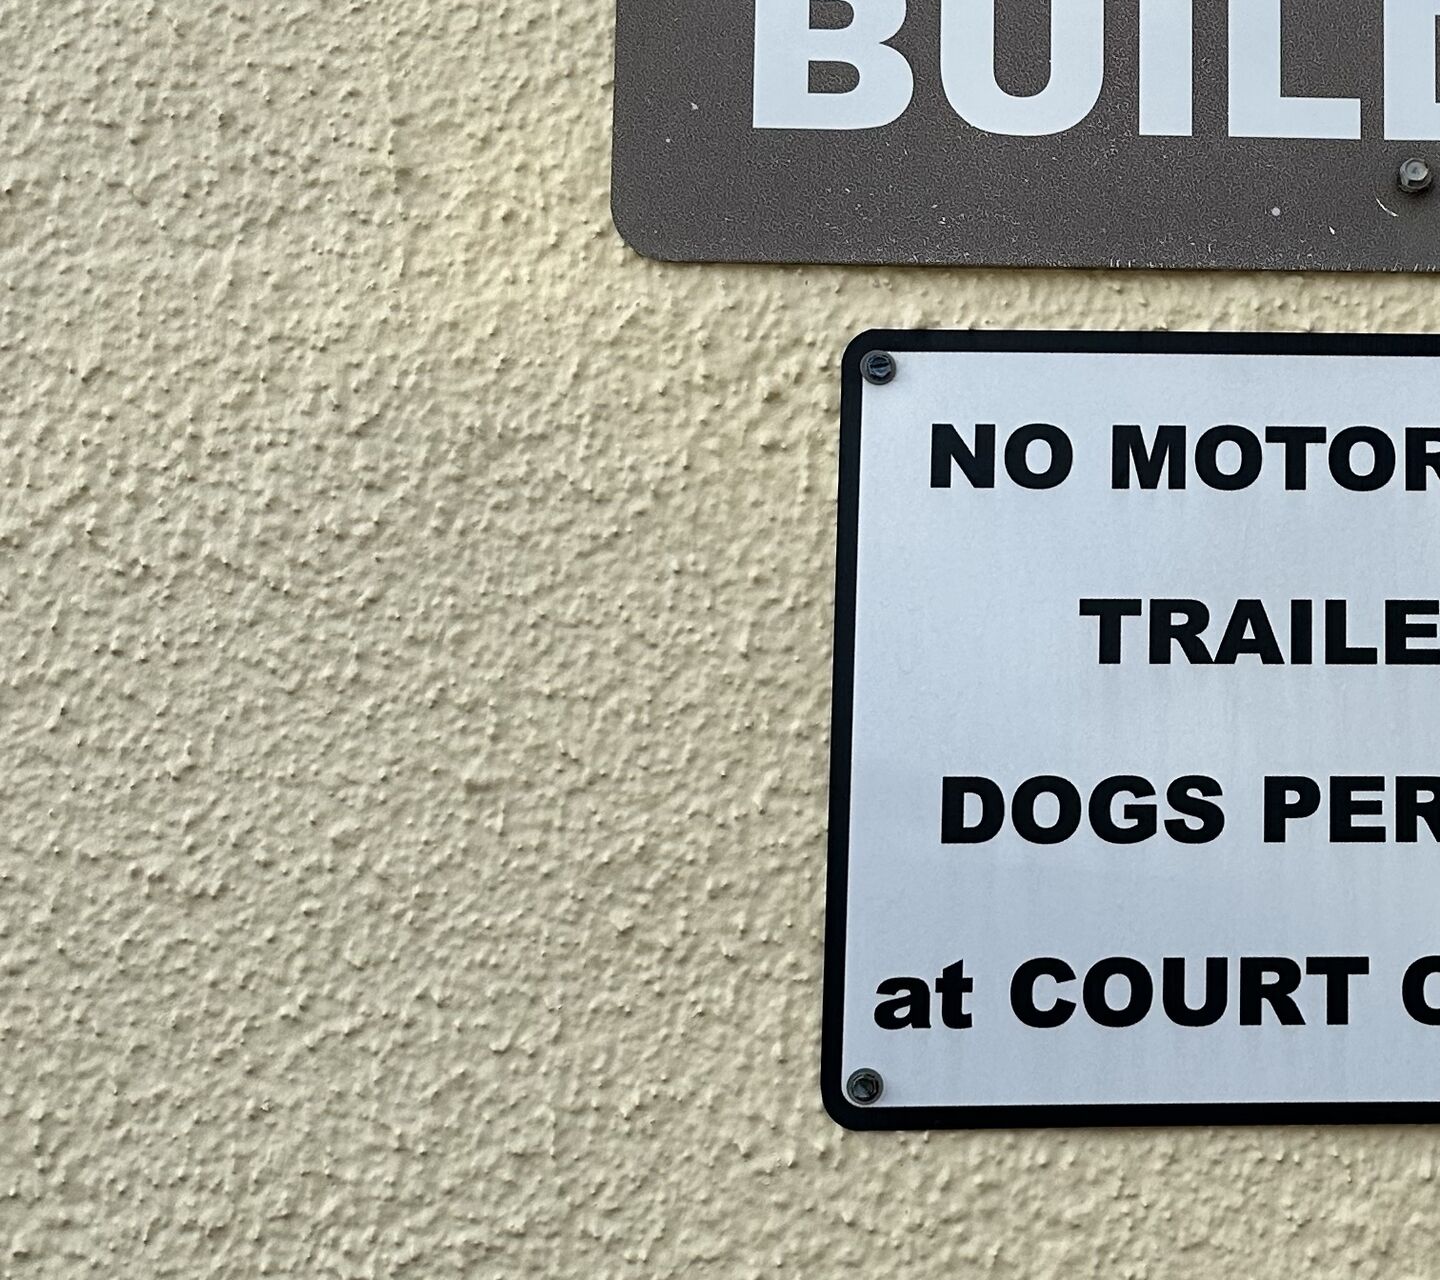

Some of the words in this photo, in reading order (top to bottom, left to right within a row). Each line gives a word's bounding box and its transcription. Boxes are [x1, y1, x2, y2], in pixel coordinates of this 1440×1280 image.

[929, 422, 1075, 491] NO
[939, 773, 1226, 846] DOGS
[872, 957, 975, 1032] at
[1009, 955, 1371, 1030] COURT
